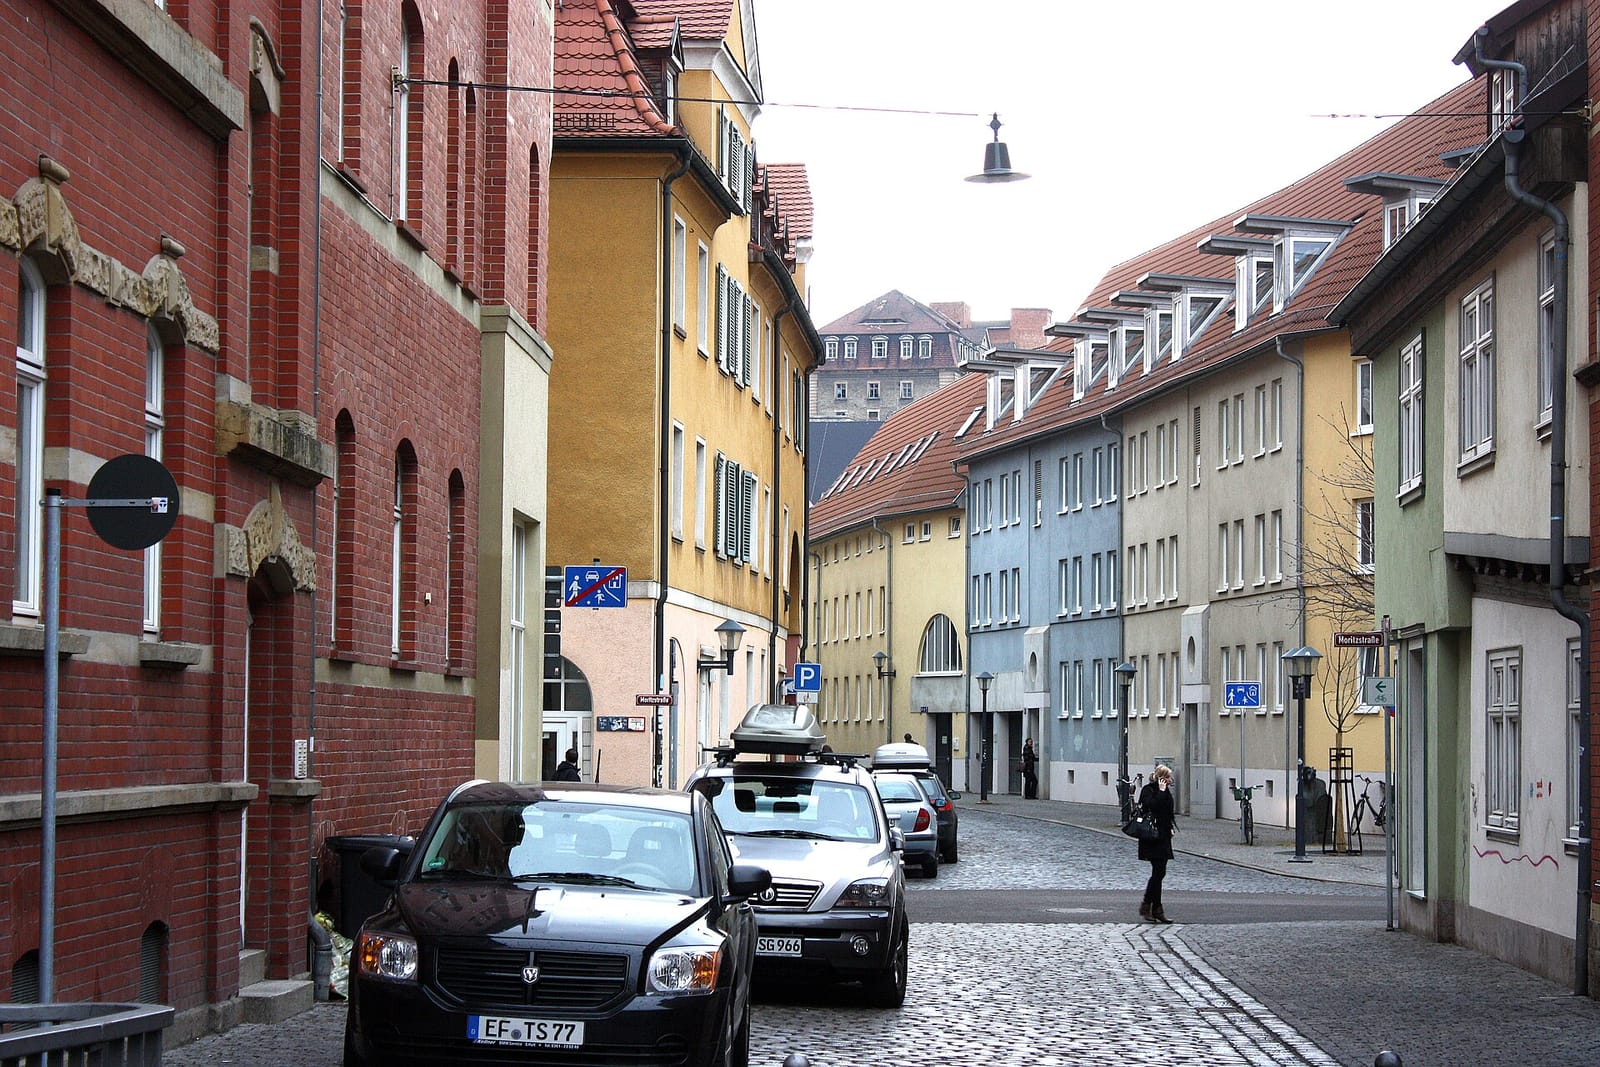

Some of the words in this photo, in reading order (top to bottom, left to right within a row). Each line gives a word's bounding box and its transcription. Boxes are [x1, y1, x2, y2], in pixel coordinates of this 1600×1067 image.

[1338, 636, 1380, 645] Moritzstraße
[800, 667, 815, 687] P
[758, 938, 775, 951] SG
[777, 939, 800, 952] 966
[485, 1019, 511, 1038] EF
[524, 1021, 548, 1041] TS
[552, 1023, 576, 1042] 77
